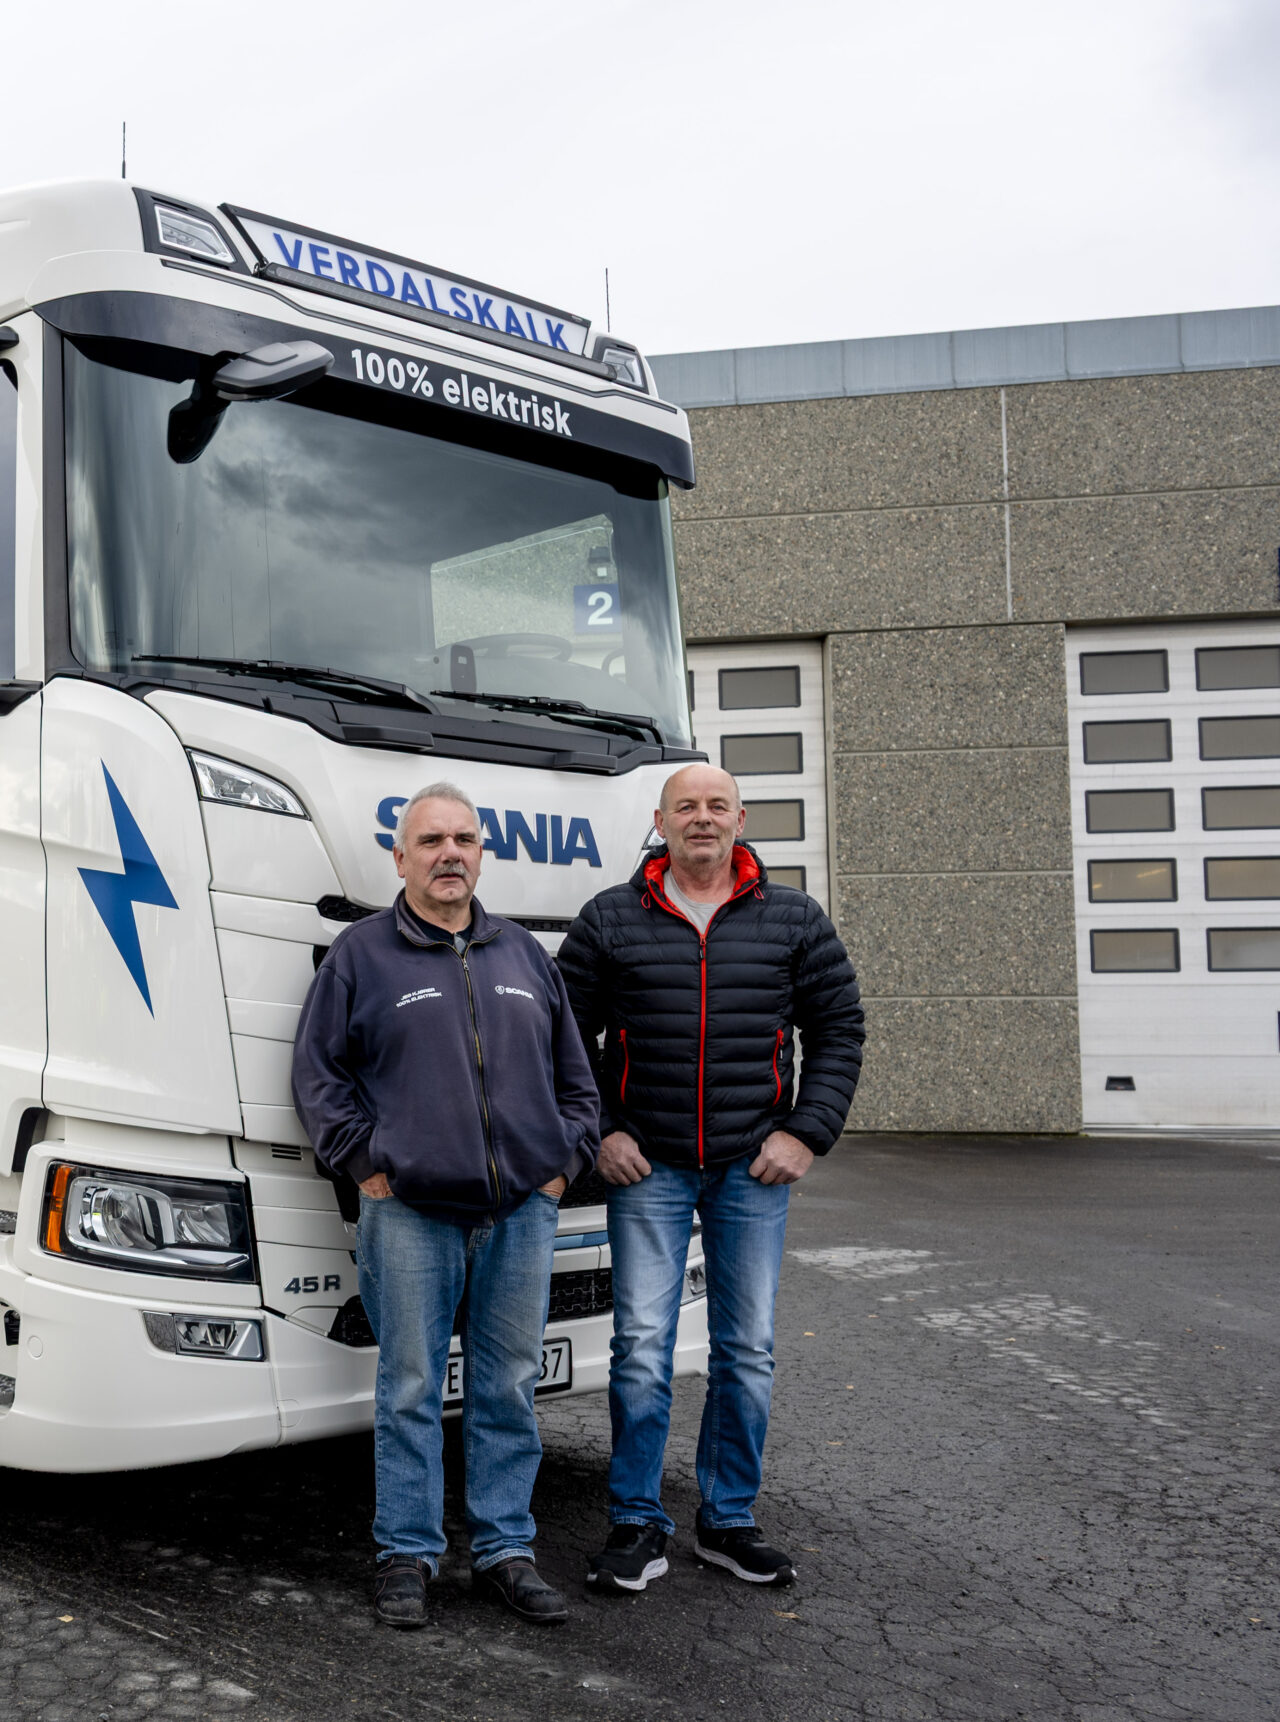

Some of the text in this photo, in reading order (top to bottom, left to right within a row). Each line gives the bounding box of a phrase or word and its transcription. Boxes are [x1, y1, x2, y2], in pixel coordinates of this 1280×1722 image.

[272, 232, 570, 352] VERDALSKALK
[350, 347, 574, 438] 100% elektrisk
[587, 591, 613, 625] 2
[373, 796, 603, 868] SANIA
[284, 1274, 341, 1294] 45 R
